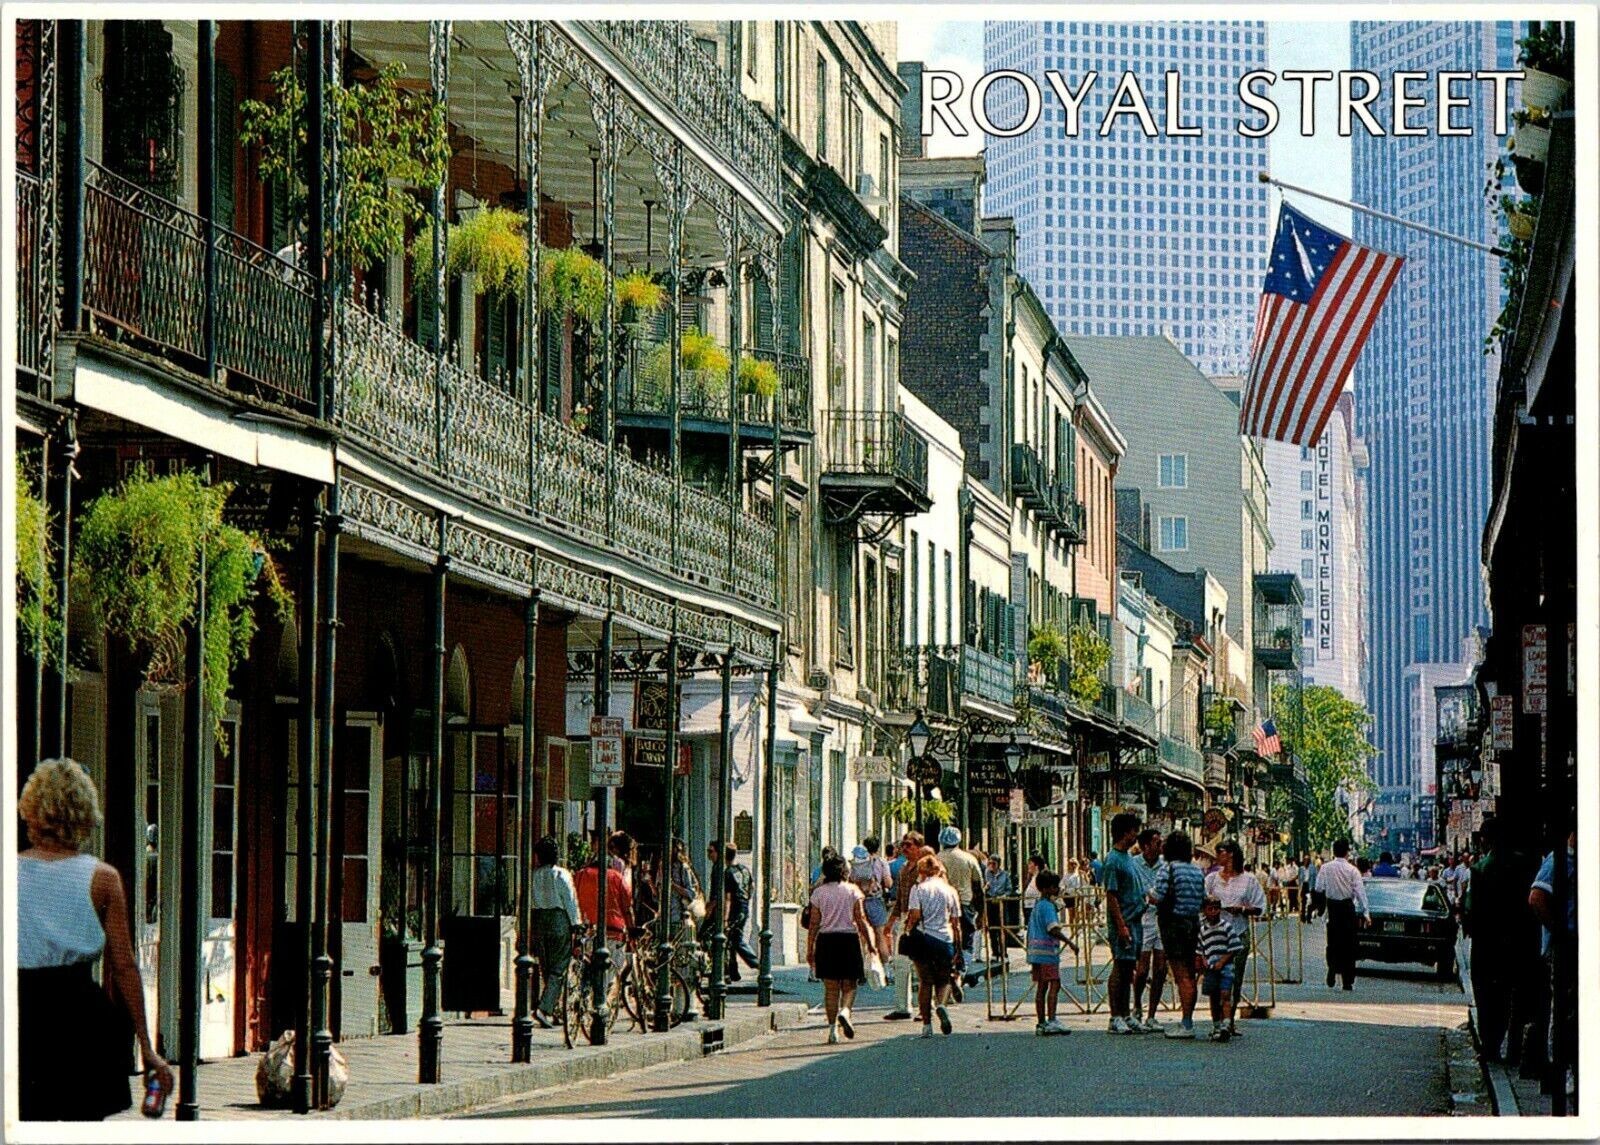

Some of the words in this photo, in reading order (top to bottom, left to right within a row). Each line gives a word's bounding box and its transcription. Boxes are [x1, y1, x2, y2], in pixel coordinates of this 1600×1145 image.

[1319, 431, 1329, 500] HOTEL
[1318, 510, 1330, 649] MONTELEONE
[595, 753, 619, 765] LANE
[596, 740, 618, 752] FIRE
